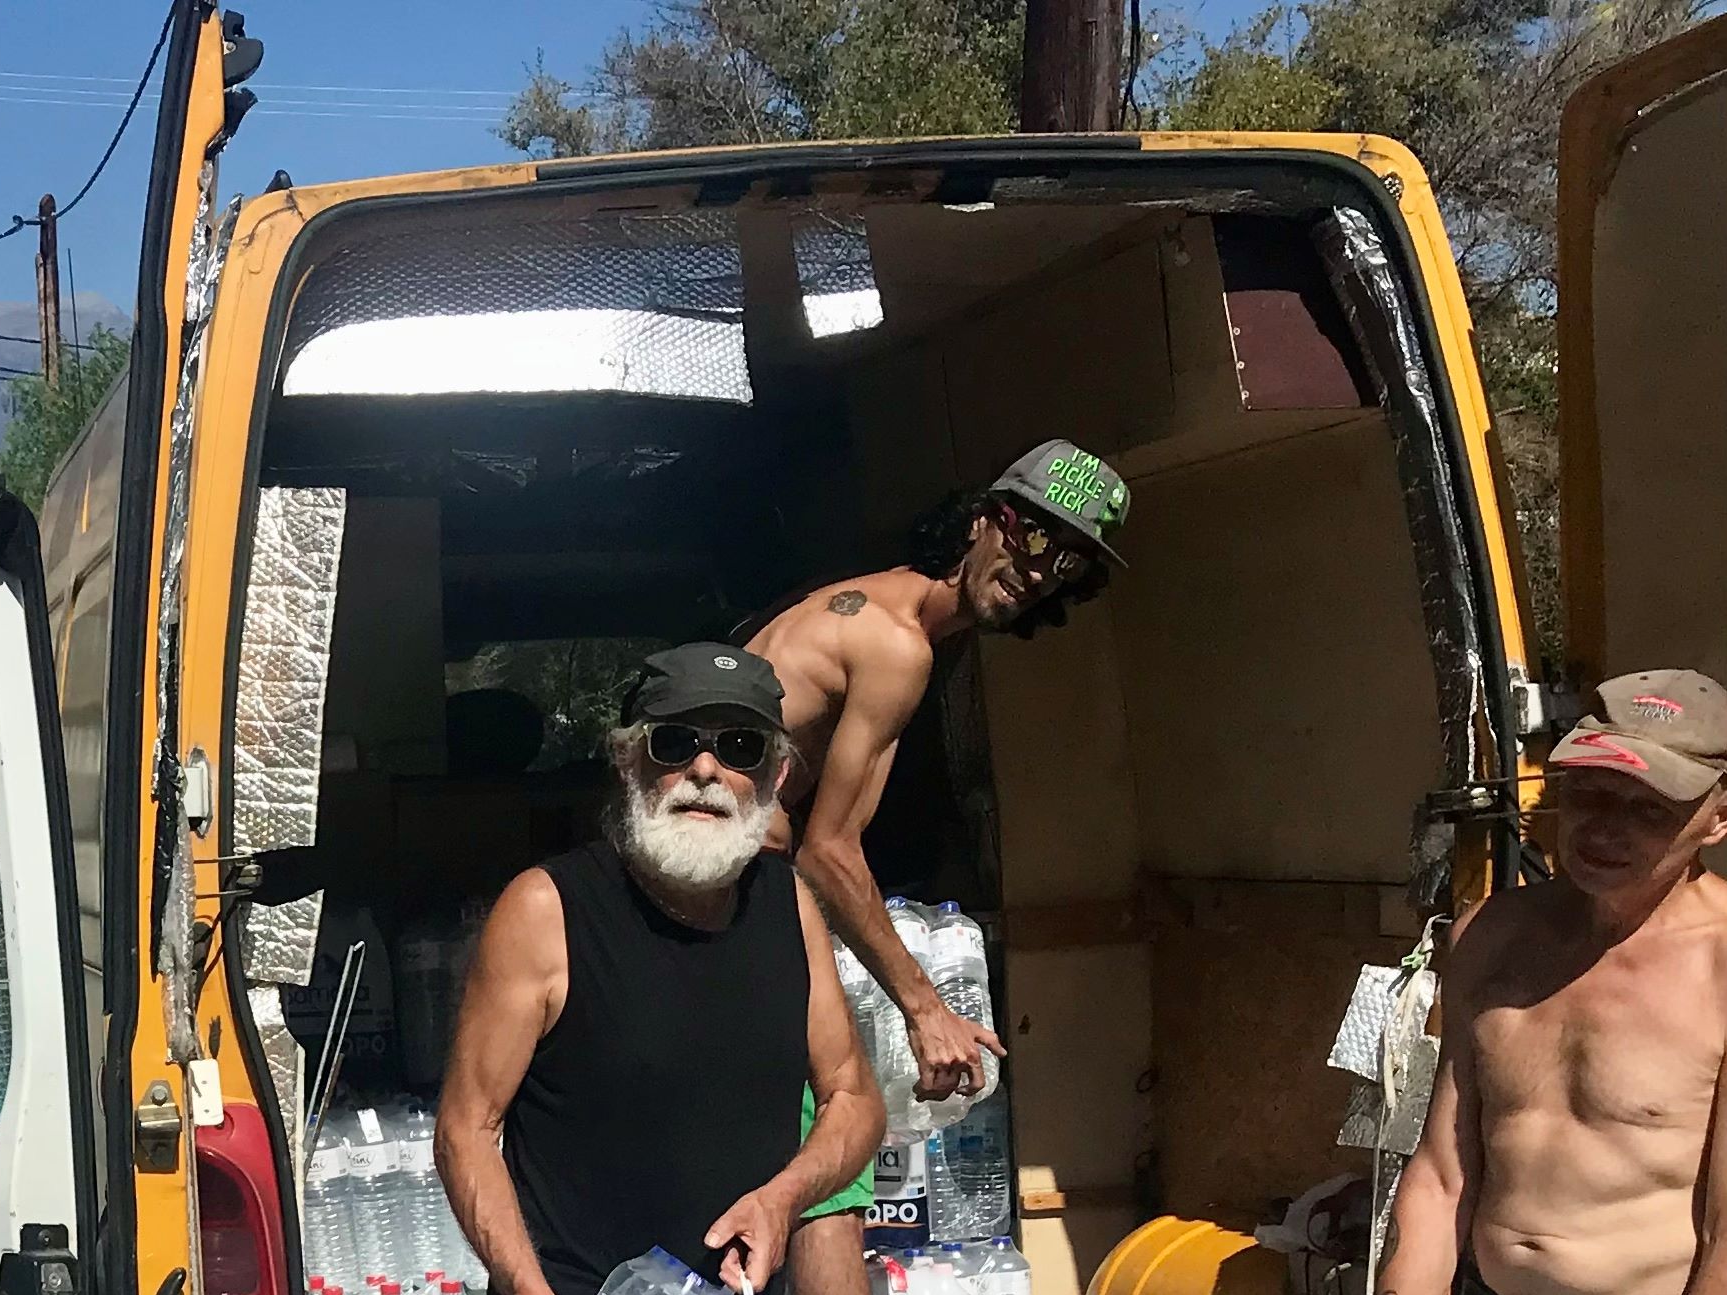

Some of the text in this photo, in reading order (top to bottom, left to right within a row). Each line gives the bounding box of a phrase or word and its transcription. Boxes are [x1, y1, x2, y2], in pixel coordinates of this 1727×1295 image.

[1071, 448, 1101, 472] I'M
[1047, 458, 1106, 500] PICKLE
[1044, 482, 1089, 516] RICK
